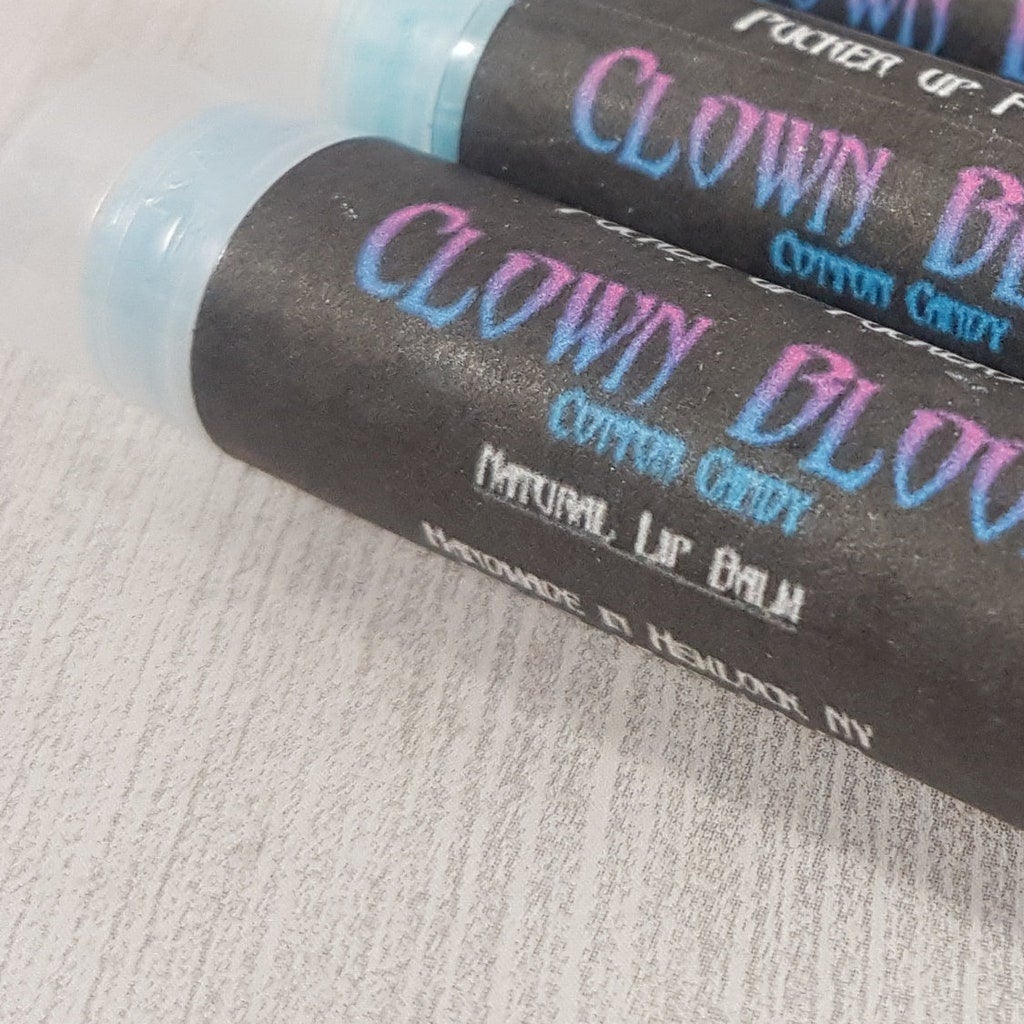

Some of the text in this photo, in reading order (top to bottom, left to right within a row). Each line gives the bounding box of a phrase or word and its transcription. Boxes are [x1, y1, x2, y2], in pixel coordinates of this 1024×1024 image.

[572, 45, 892, 246] CLOWN
[354, 202, 713, 408] CLOWN
[634, 510, 693, 568] LIP
